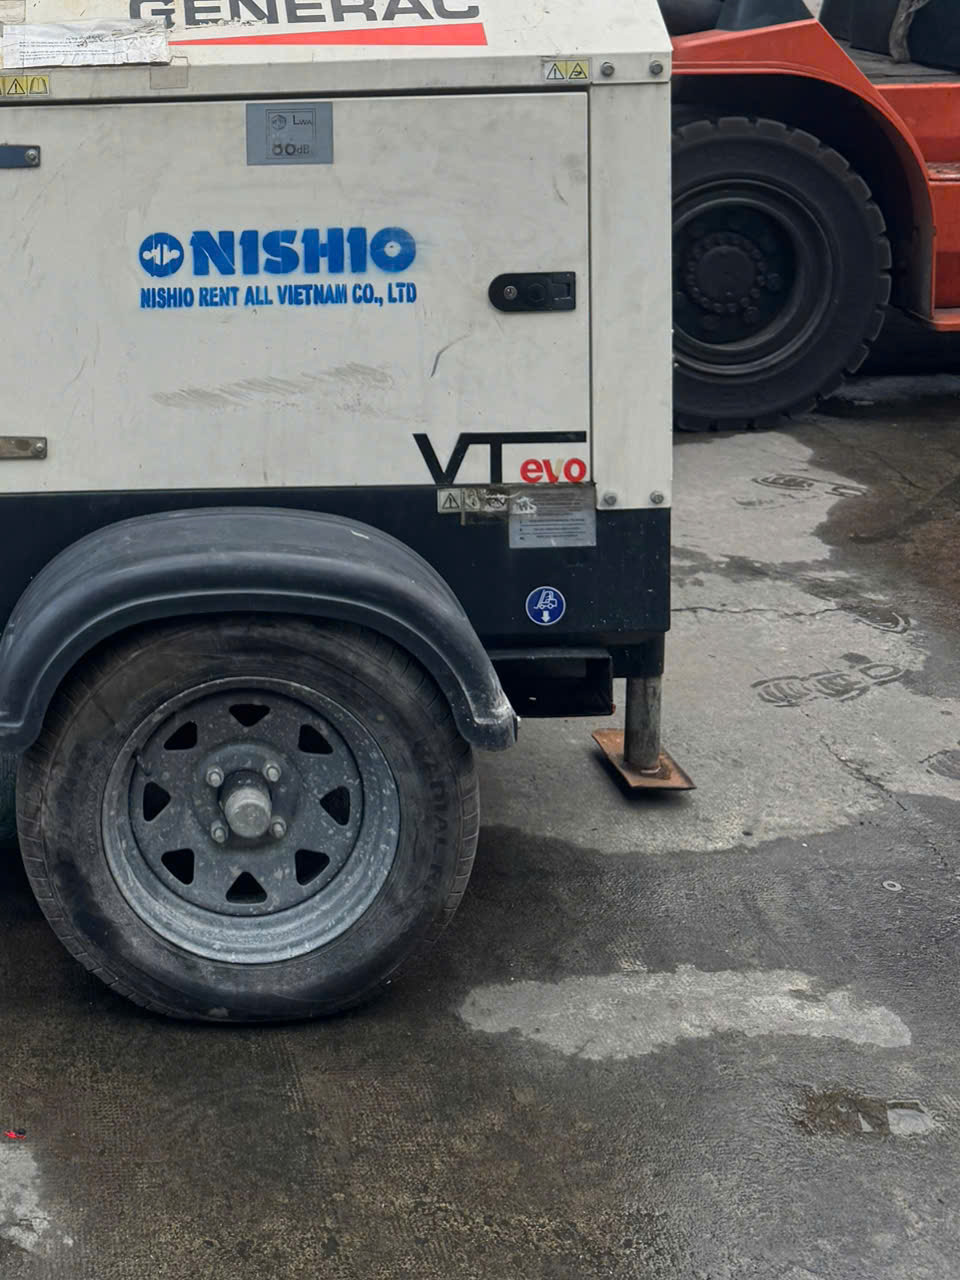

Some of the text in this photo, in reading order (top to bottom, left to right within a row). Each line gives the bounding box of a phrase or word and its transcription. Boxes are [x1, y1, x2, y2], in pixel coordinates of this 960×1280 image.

[190, 226, 417, 276] NISHIO
[140, 282, 417, 308] NISHIO RENT ALL VIETNAM CO., LTD
[520, 458, 587, 484] evo
